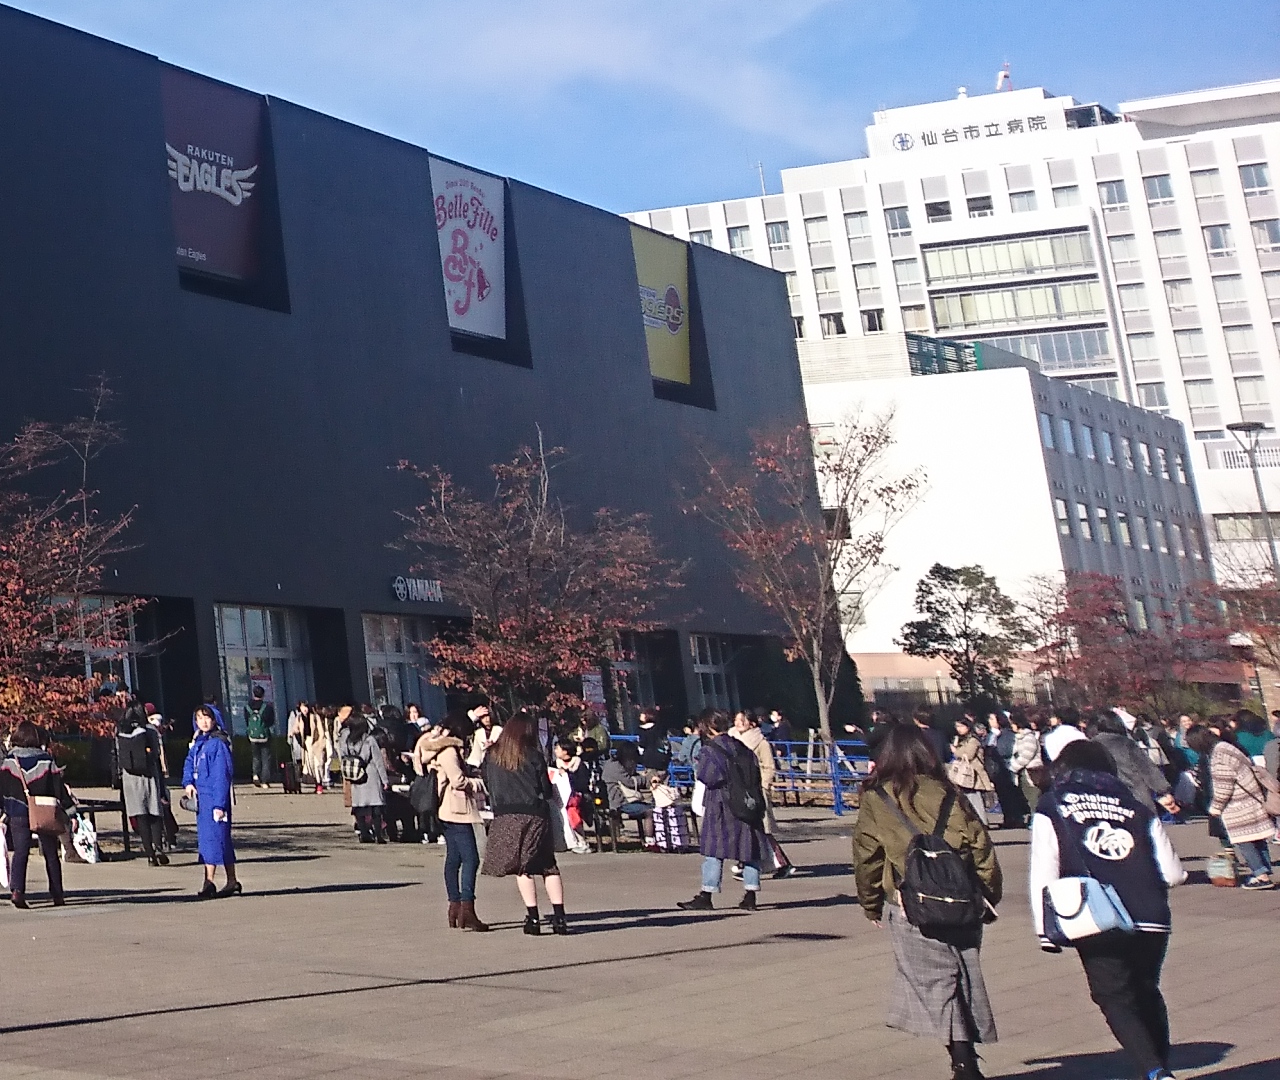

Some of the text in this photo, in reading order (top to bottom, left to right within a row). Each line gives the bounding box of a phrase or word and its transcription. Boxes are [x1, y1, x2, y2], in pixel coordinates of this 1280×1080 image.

[920, 114, 1048, 147] 仙台市立病院
[187, 144, 234, 167] RAKUTEN
[169, 151, 254, 207] EAGLES
[435, 194, 498, 242] Belle Fille
[406, 577, 444, 603] YAMAHA
